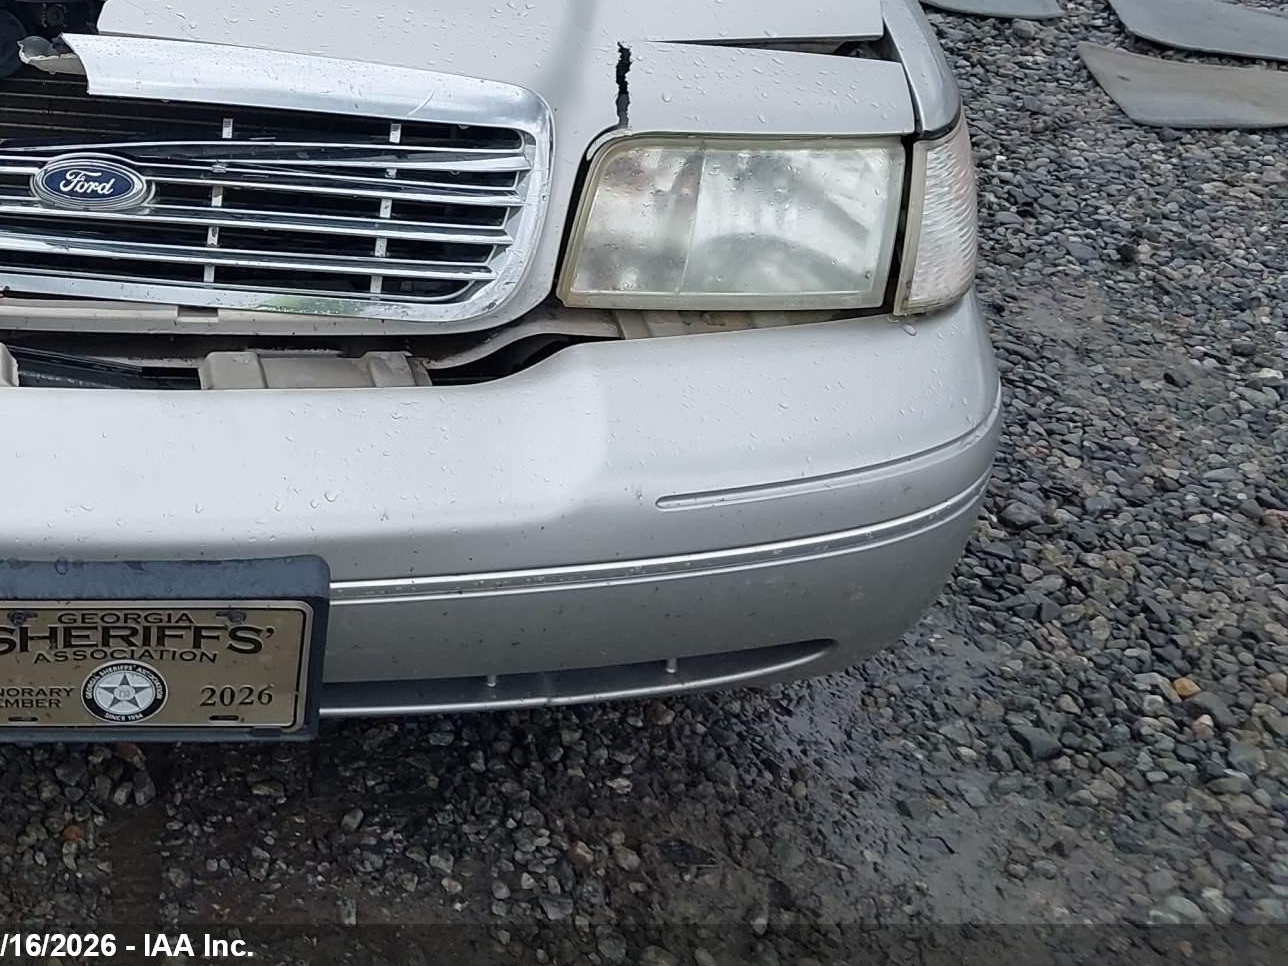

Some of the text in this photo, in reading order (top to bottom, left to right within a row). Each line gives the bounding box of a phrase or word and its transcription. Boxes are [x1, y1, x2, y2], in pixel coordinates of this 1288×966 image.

[59, 169, 115, 195] Ford
[57, 612, 195, 625] GEORGIA
[33, 648, 218, 665] ASSOCIATION
[200, 685, 274, 707] 2026
